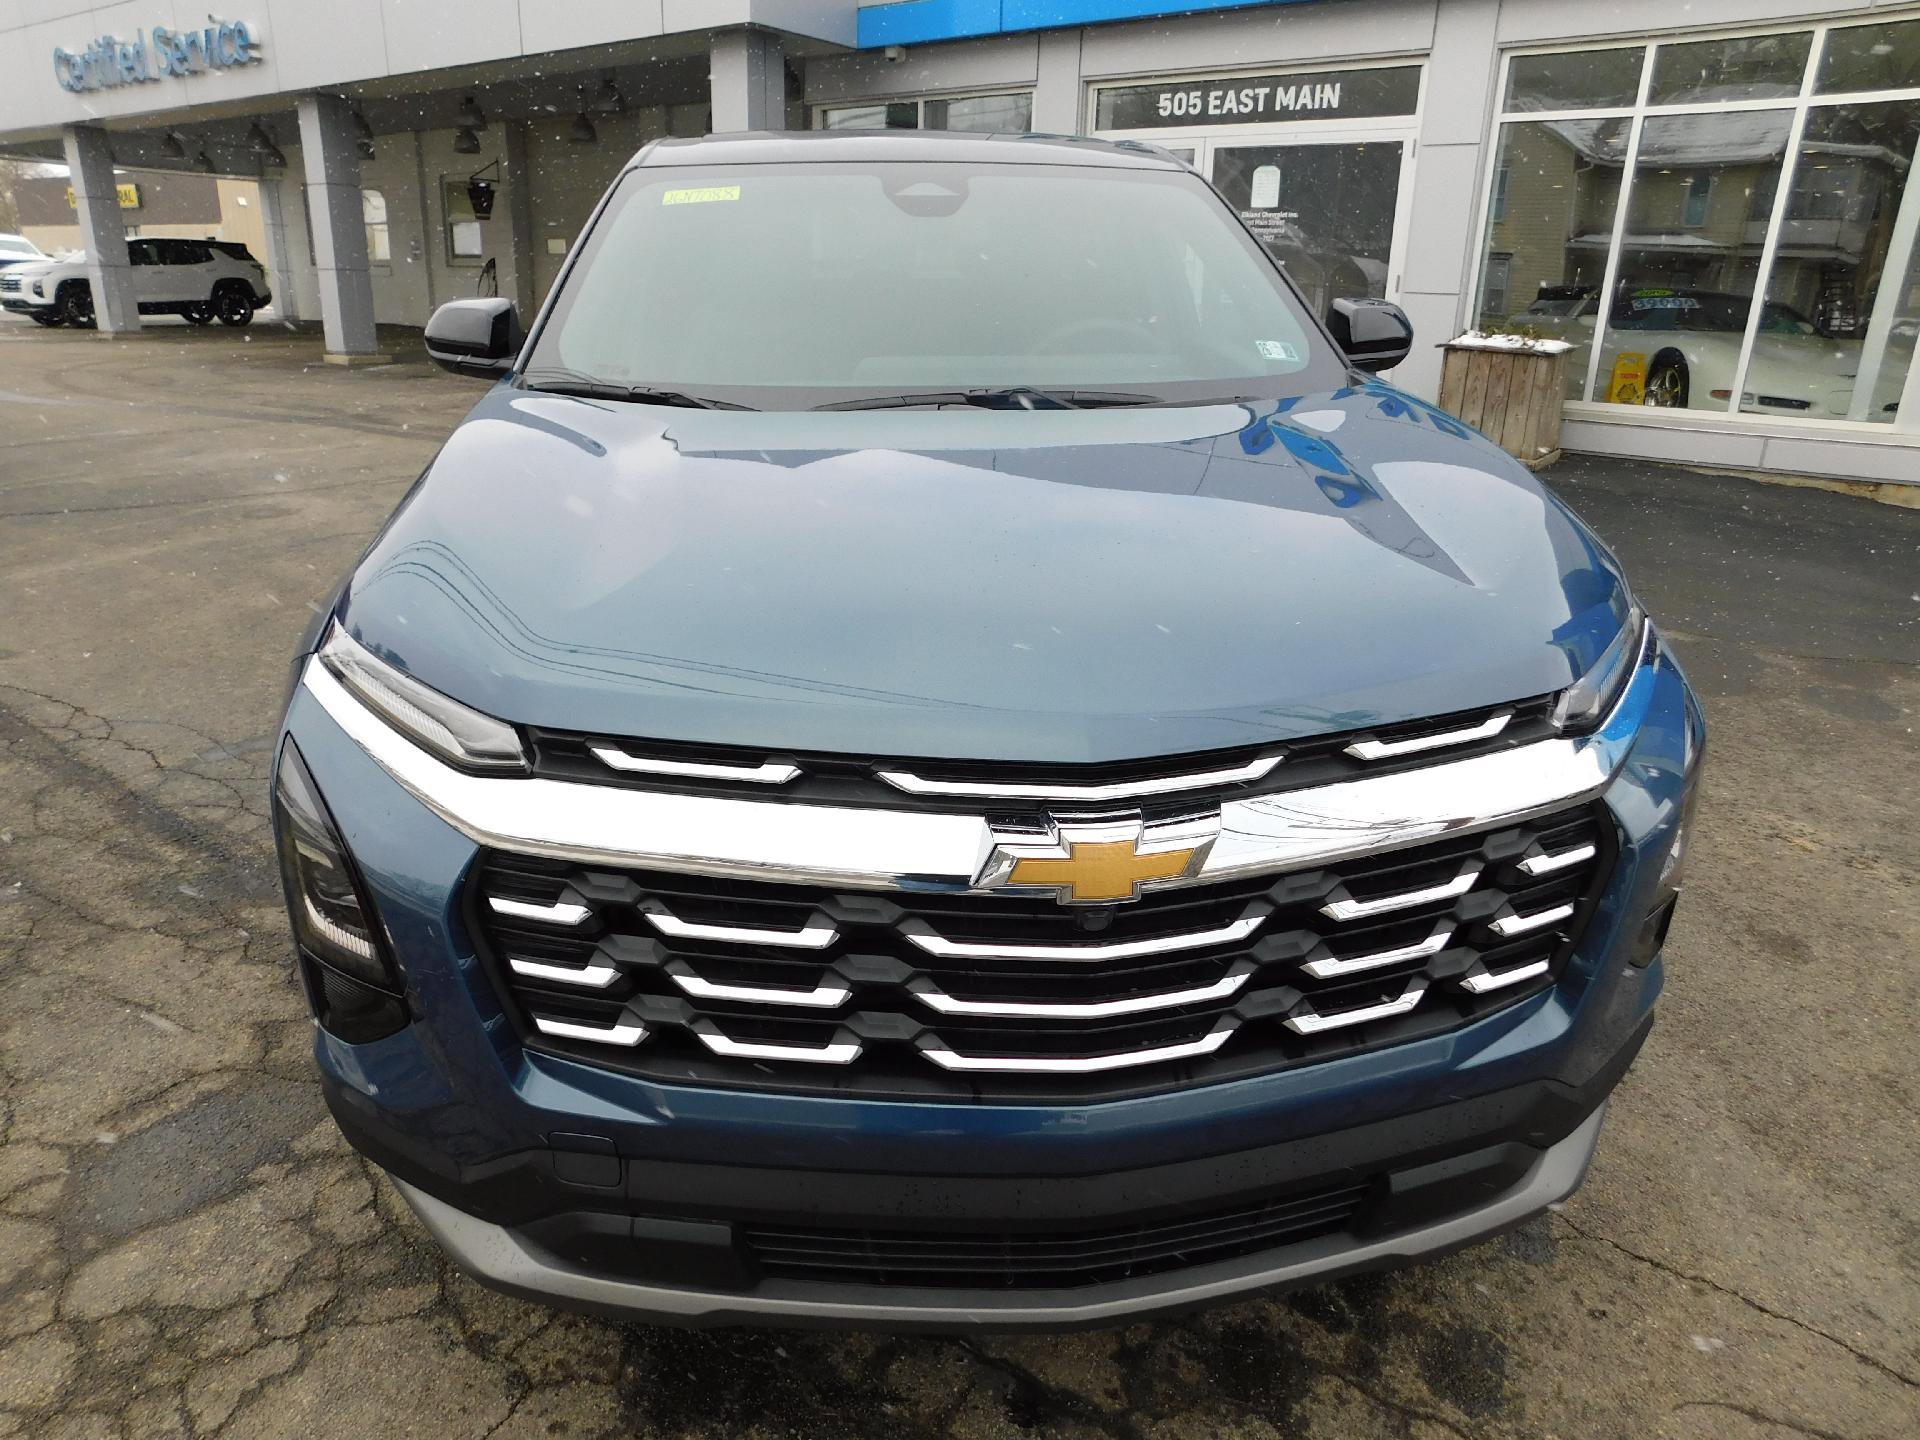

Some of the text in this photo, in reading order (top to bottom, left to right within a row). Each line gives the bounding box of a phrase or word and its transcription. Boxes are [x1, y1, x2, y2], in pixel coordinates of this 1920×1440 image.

[54, 14, 252, 91] Certified Service
[1158, 82, 1341, 117] 505 EAST MAIN
